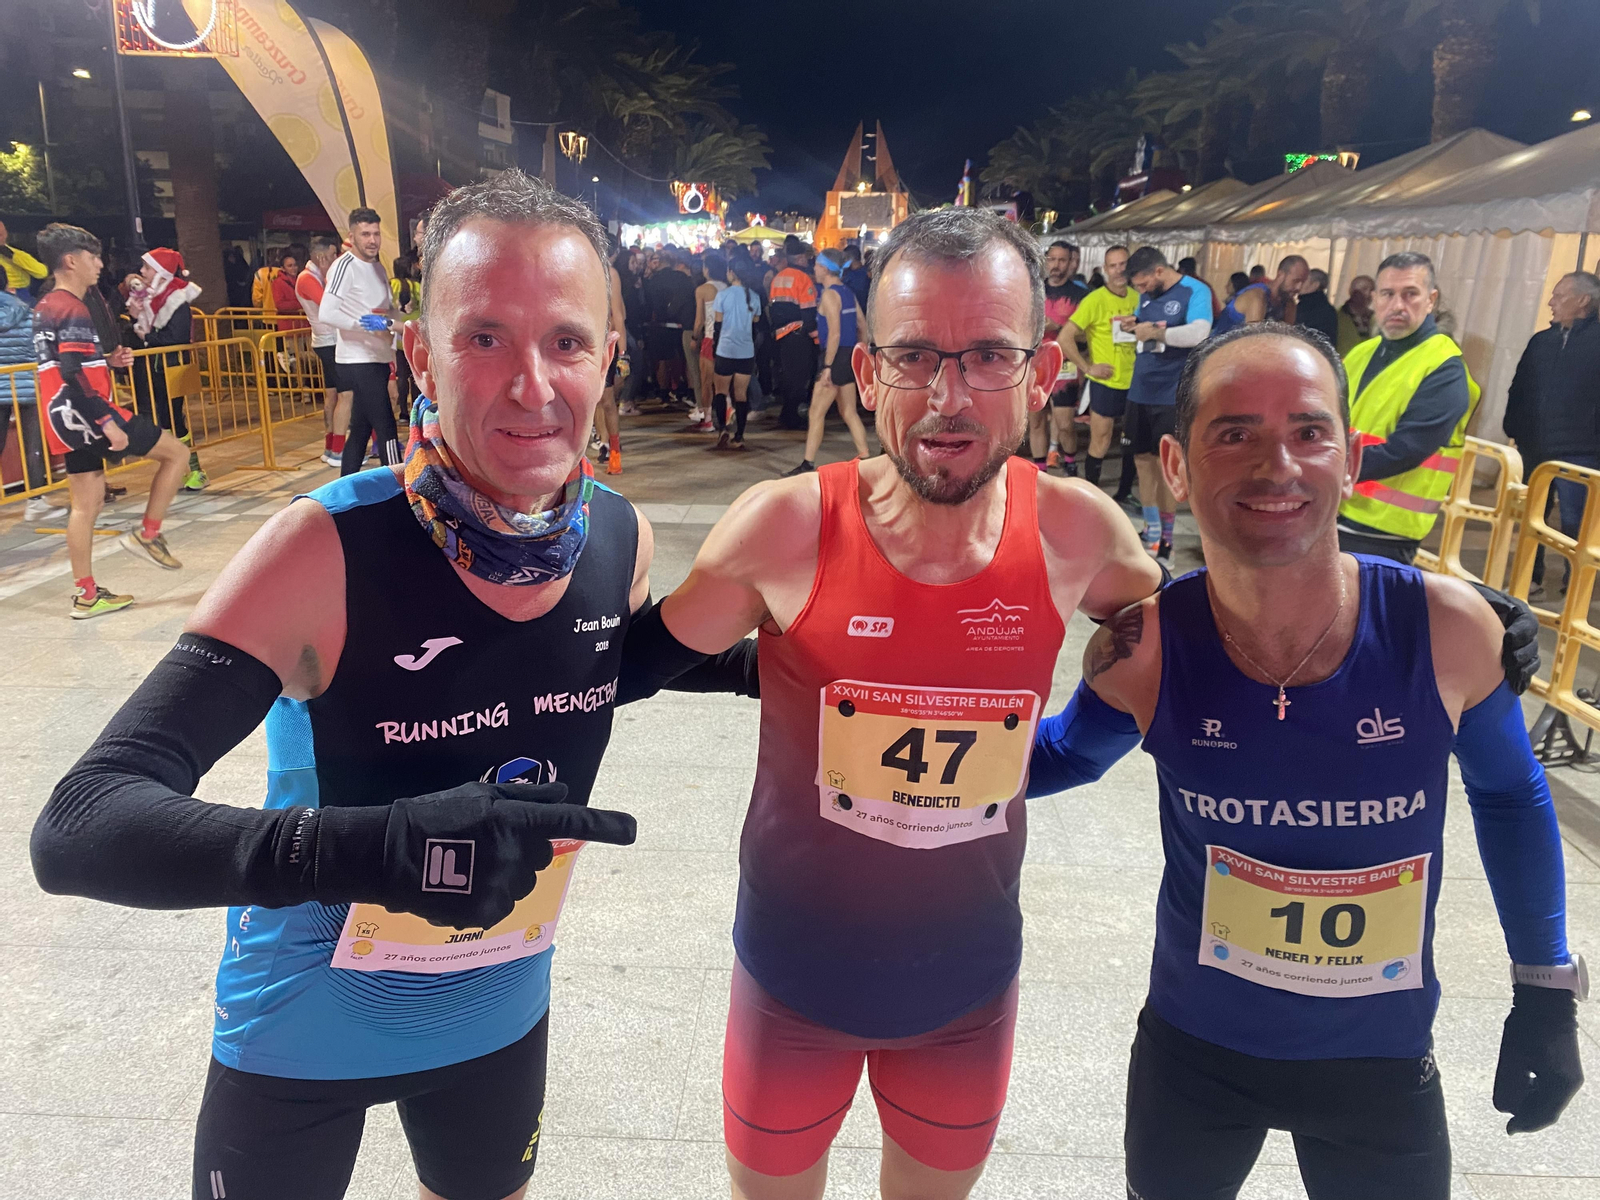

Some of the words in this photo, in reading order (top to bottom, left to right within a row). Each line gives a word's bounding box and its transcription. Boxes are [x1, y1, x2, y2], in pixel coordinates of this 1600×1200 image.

[573, 618, 599, 633] Jean
[601, 614, 621, 630] Bouin
[966, 625, 1025, 636] ANDÚJAR
[595, 640, 609, 652] 2018
[832, 685, 869, 700] XXVII
[872, 691, 902, 704] SAN
[905, 694, 977, 708] SILVESTRE
[979, 695, 1024, 709] BAILÉN
[375, 702, 509, 744] RUNNING
[1356, 708, 1405, 740] als
[881, 727, 977, 785] 47
[892, 790, 961, 809] BENEDICTO
[1178, 788, 1426, 827] TROTASIERRA
[856, 810, 867, 820] 27
[869, 813, 895, 826] años
[896, 820, 945, 833] corriendo
[945, 820, 973, 833] juntos
[1217, 850, 1252, 873] XXVII
[1255, 867, 1285, 883] SAN
[1288, 875, 1366, 888] SILVESTRE
[1369, 862, 1416, 883] BAILÉN
[1270, 901, 1367, 949] 10
[444, 930, 484, 944] JUANI
[383, 953, 399, 961] 27
[400, 954, 427, 963] años
[429, 950, 479, 962] corriendo
[479, 944, 512, 957] juntos
[1265, 947, 1309, 964] NEREA
[1314, 955, 1324, 965] Y
[1327, 955, 1364, 966] FELIX
[1240, 958, 1254, 969] 27
[1255, 964, 1282, 978] años
[1283, 973, 1338, 985] corriendo
[1339, 974, 1374, 986] juntos
